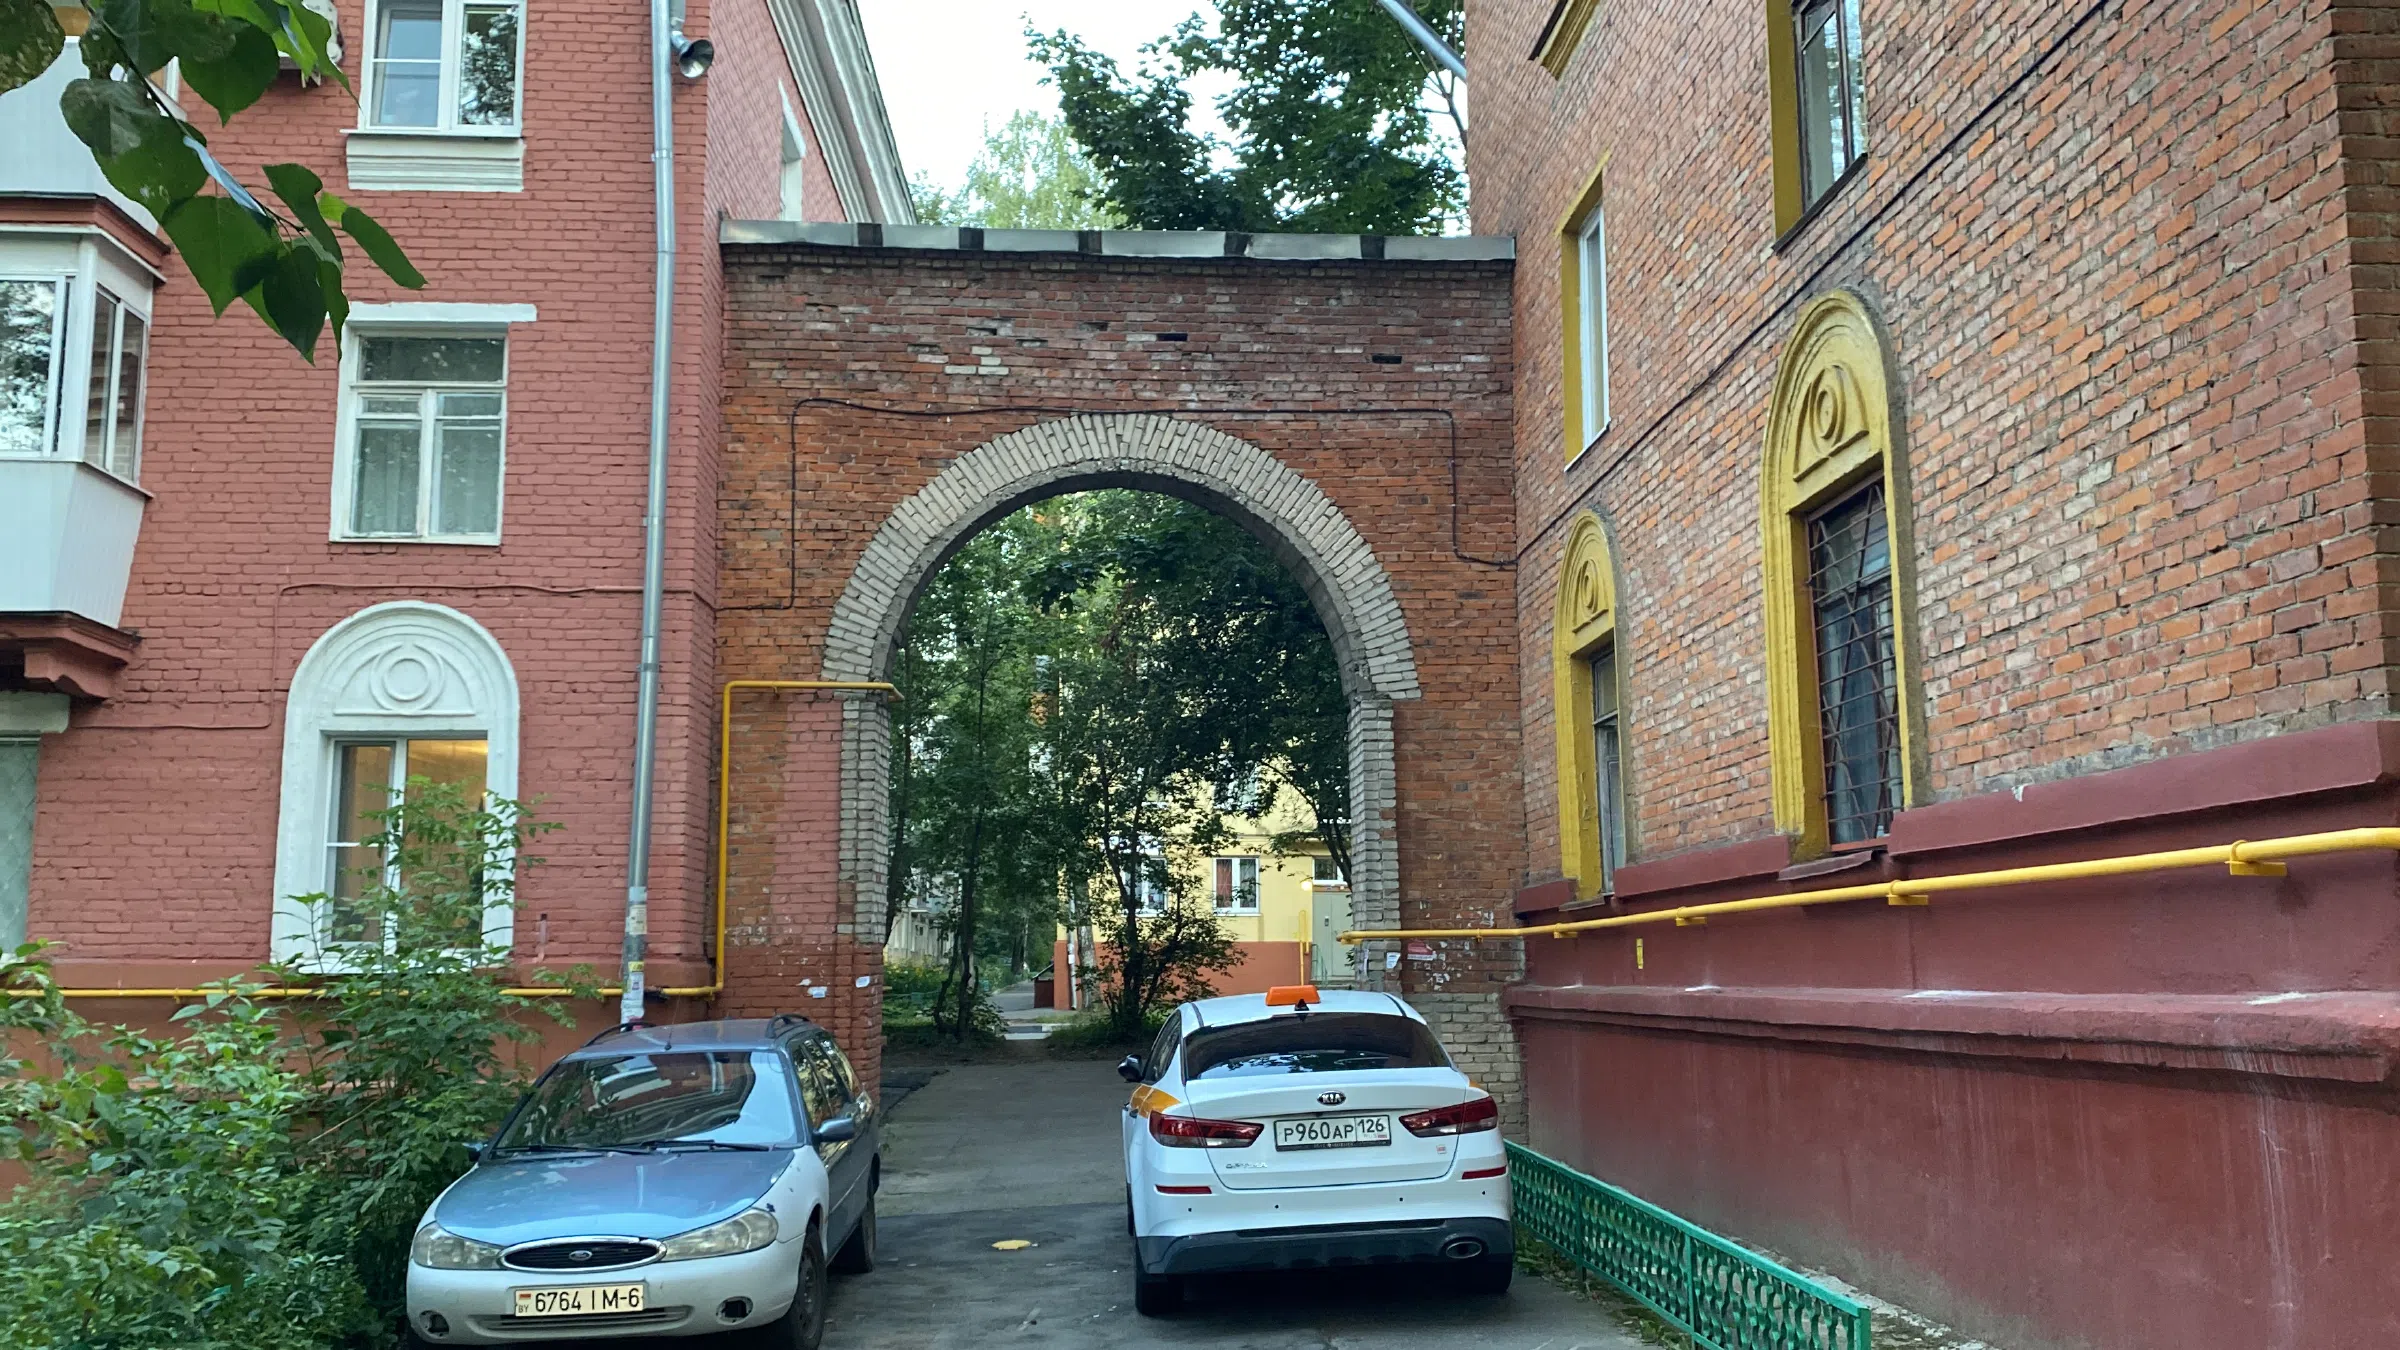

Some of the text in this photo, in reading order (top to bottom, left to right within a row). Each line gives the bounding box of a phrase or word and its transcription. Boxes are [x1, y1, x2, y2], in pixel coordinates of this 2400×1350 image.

[1357, 1118, 1386, 1133] 126
[518, 1304, 529, 1313] BY
[535, 1290, 582, 1312] 6764
